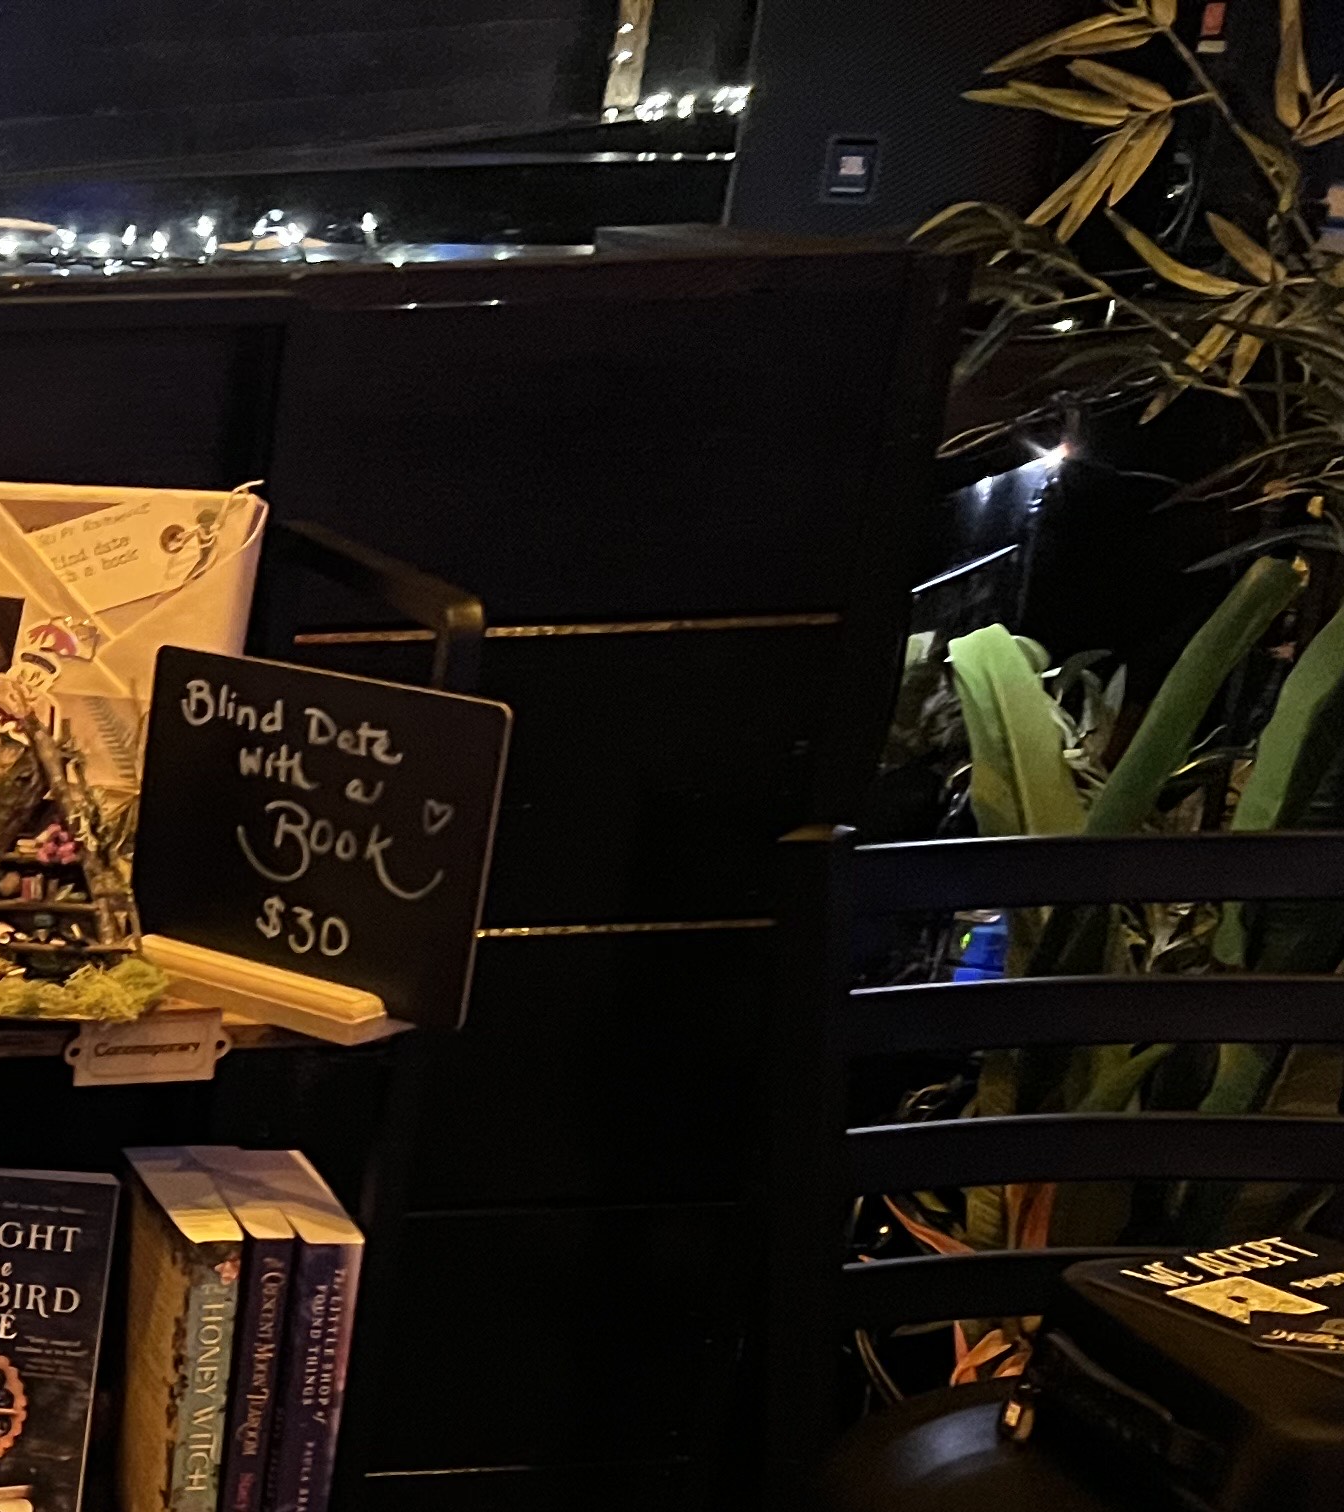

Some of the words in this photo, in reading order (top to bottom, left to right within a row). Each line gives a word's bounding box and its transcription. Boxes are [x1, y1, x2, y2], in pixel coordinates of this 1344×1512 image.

[181, 678, 284, 733] Blind
[305, 706, 403, 765] Date
[345, 775, 384, 802] a
[256, 895, 350, 957] $30
[1119, 1260, 1203, 1287] WE
[1183, 1236, 1319, 1278] ACCEPT
